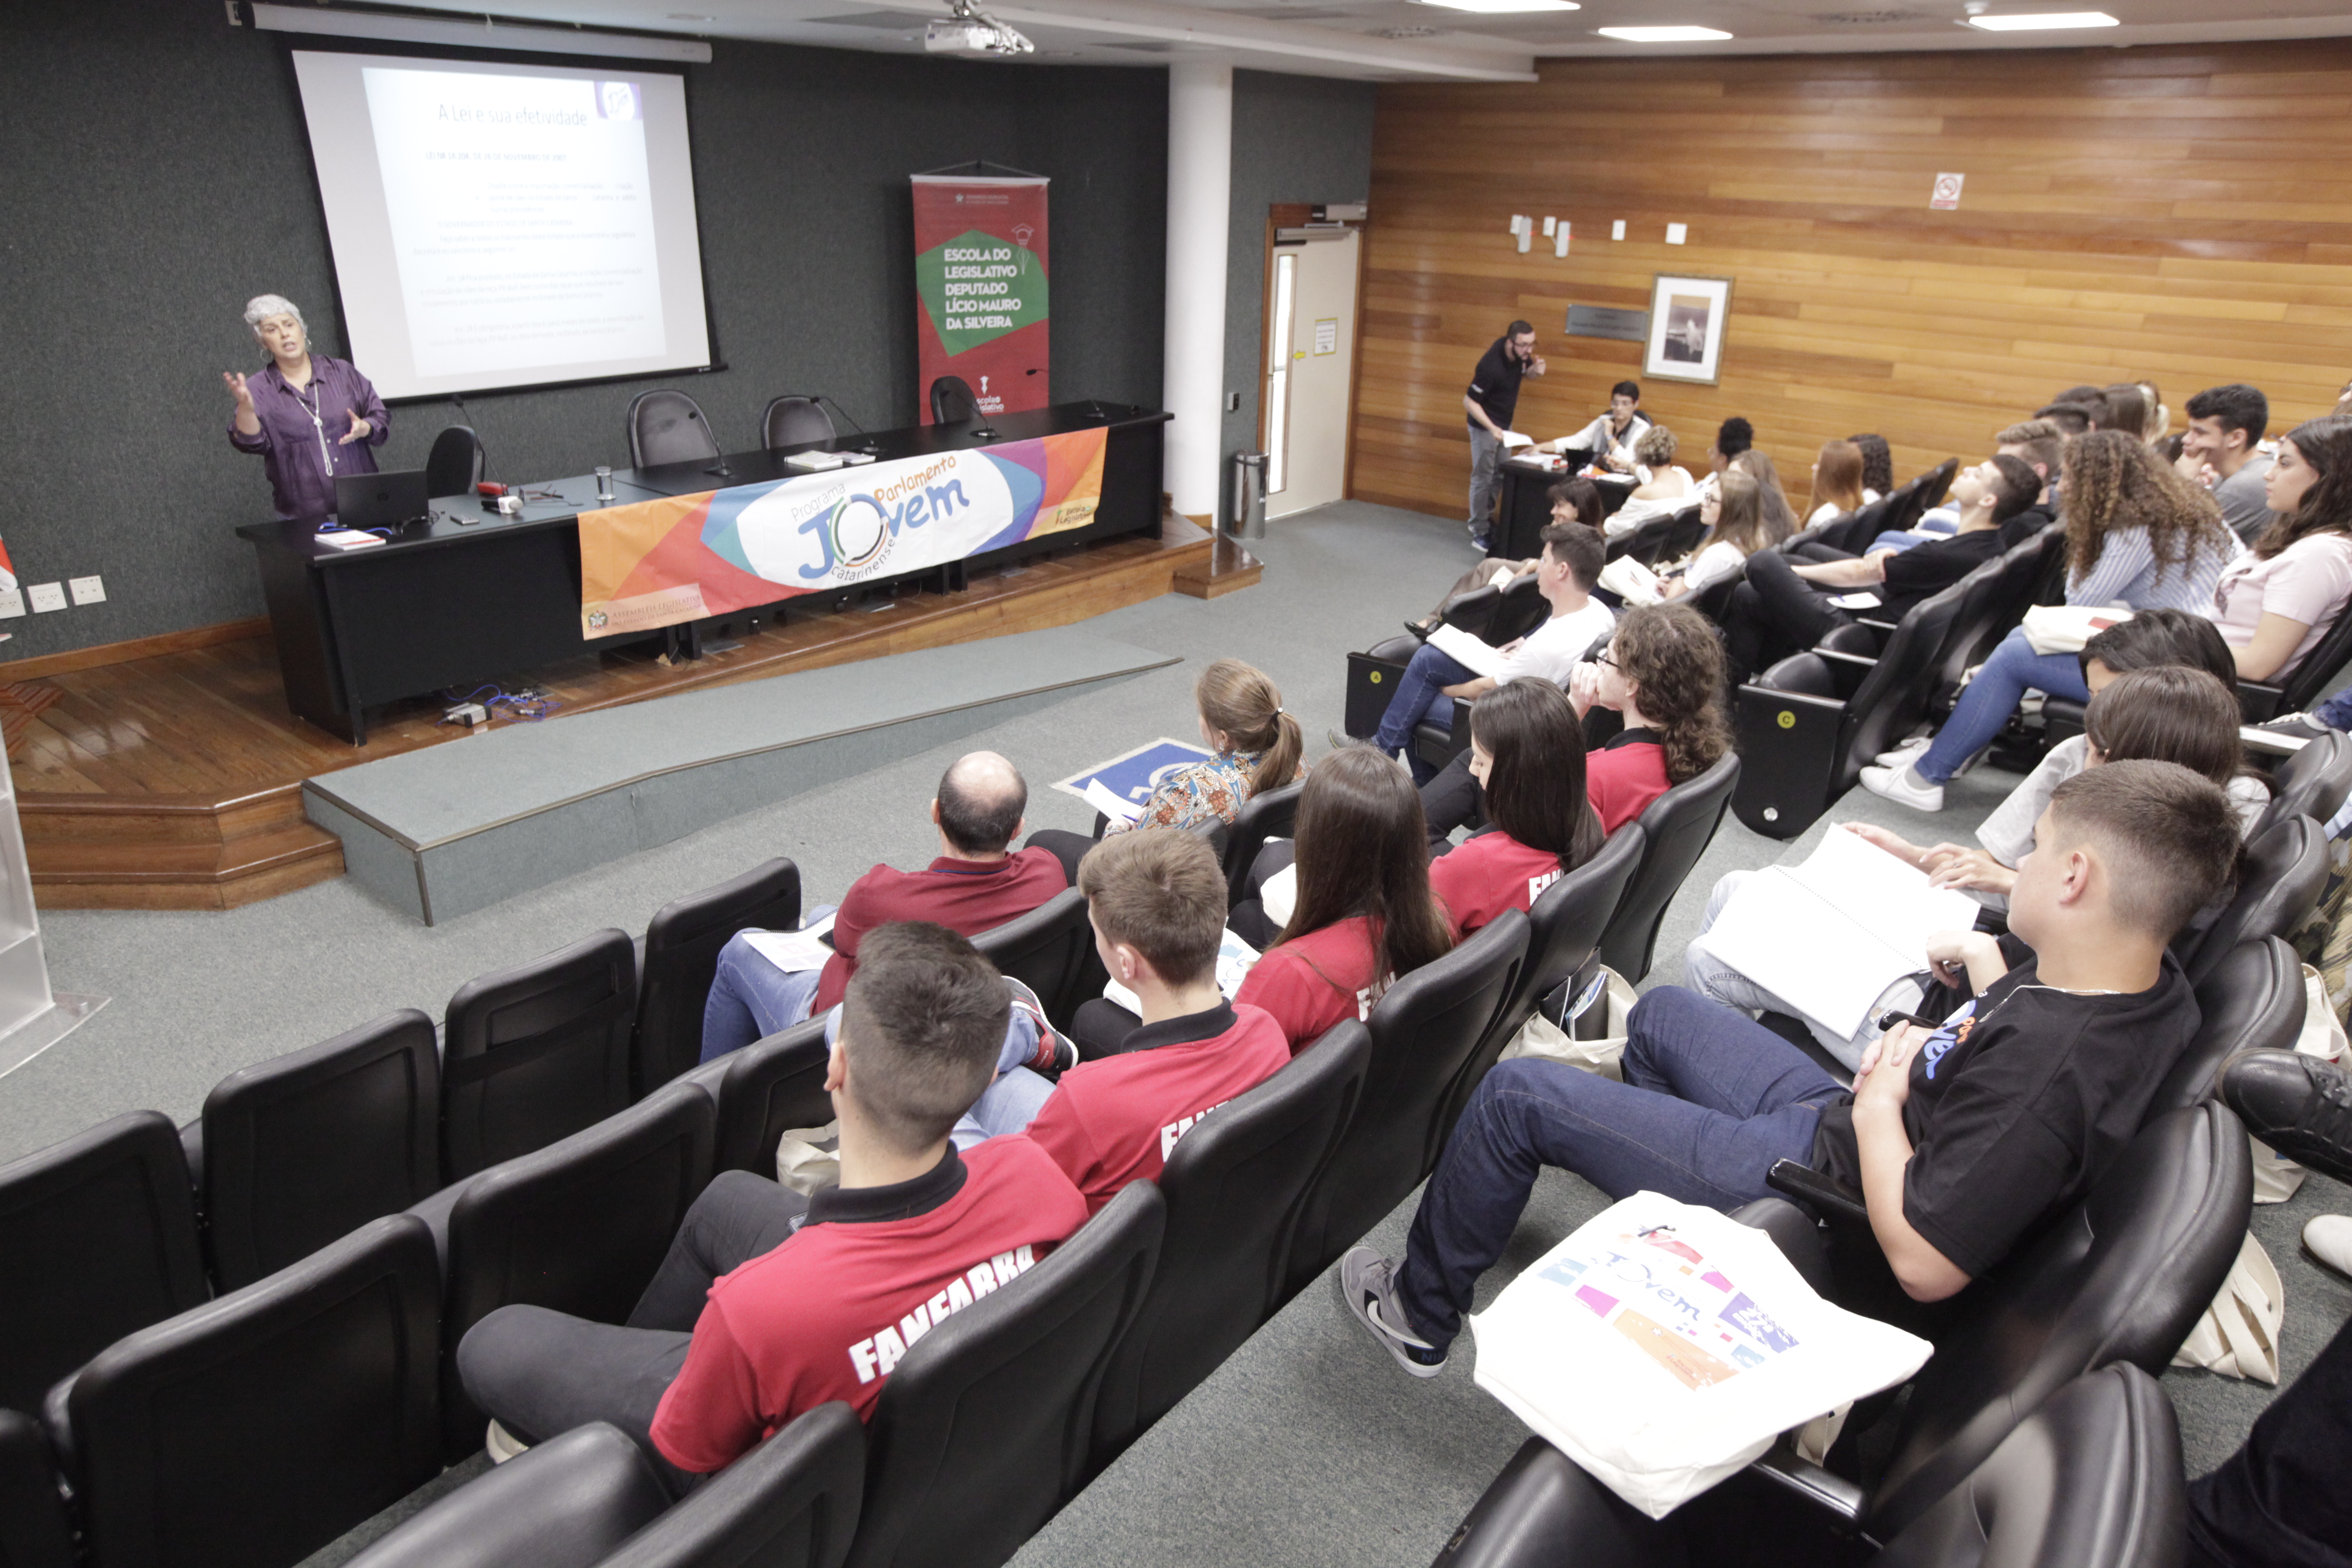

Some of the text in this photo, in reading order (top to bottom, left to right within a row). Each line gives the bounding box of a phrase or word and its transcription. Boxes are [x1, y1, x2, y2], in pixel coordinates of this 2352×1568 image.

[439, 103, 587, 126] A Lei e sua efetividade
[944, 248, 1011, 262] ESCOLA DO
[945, 265, 1017, 279] LEGISLATIVO
[945, 282, 1008, 296] DEPUTADO
[946, 297, 1022, 313] LÍCIO MAURO
[946, 315, 1013, 330] DA SILVEIRA
[976, 395, 995, 405] scola
[874, 456, 956, 505] Parlamento
[791, 483, 846, 522] Programa
[612, 594, 701, 619] ASSEMBLEIA LEGISLATIVA
[1782, 715, 1790, 724] C
